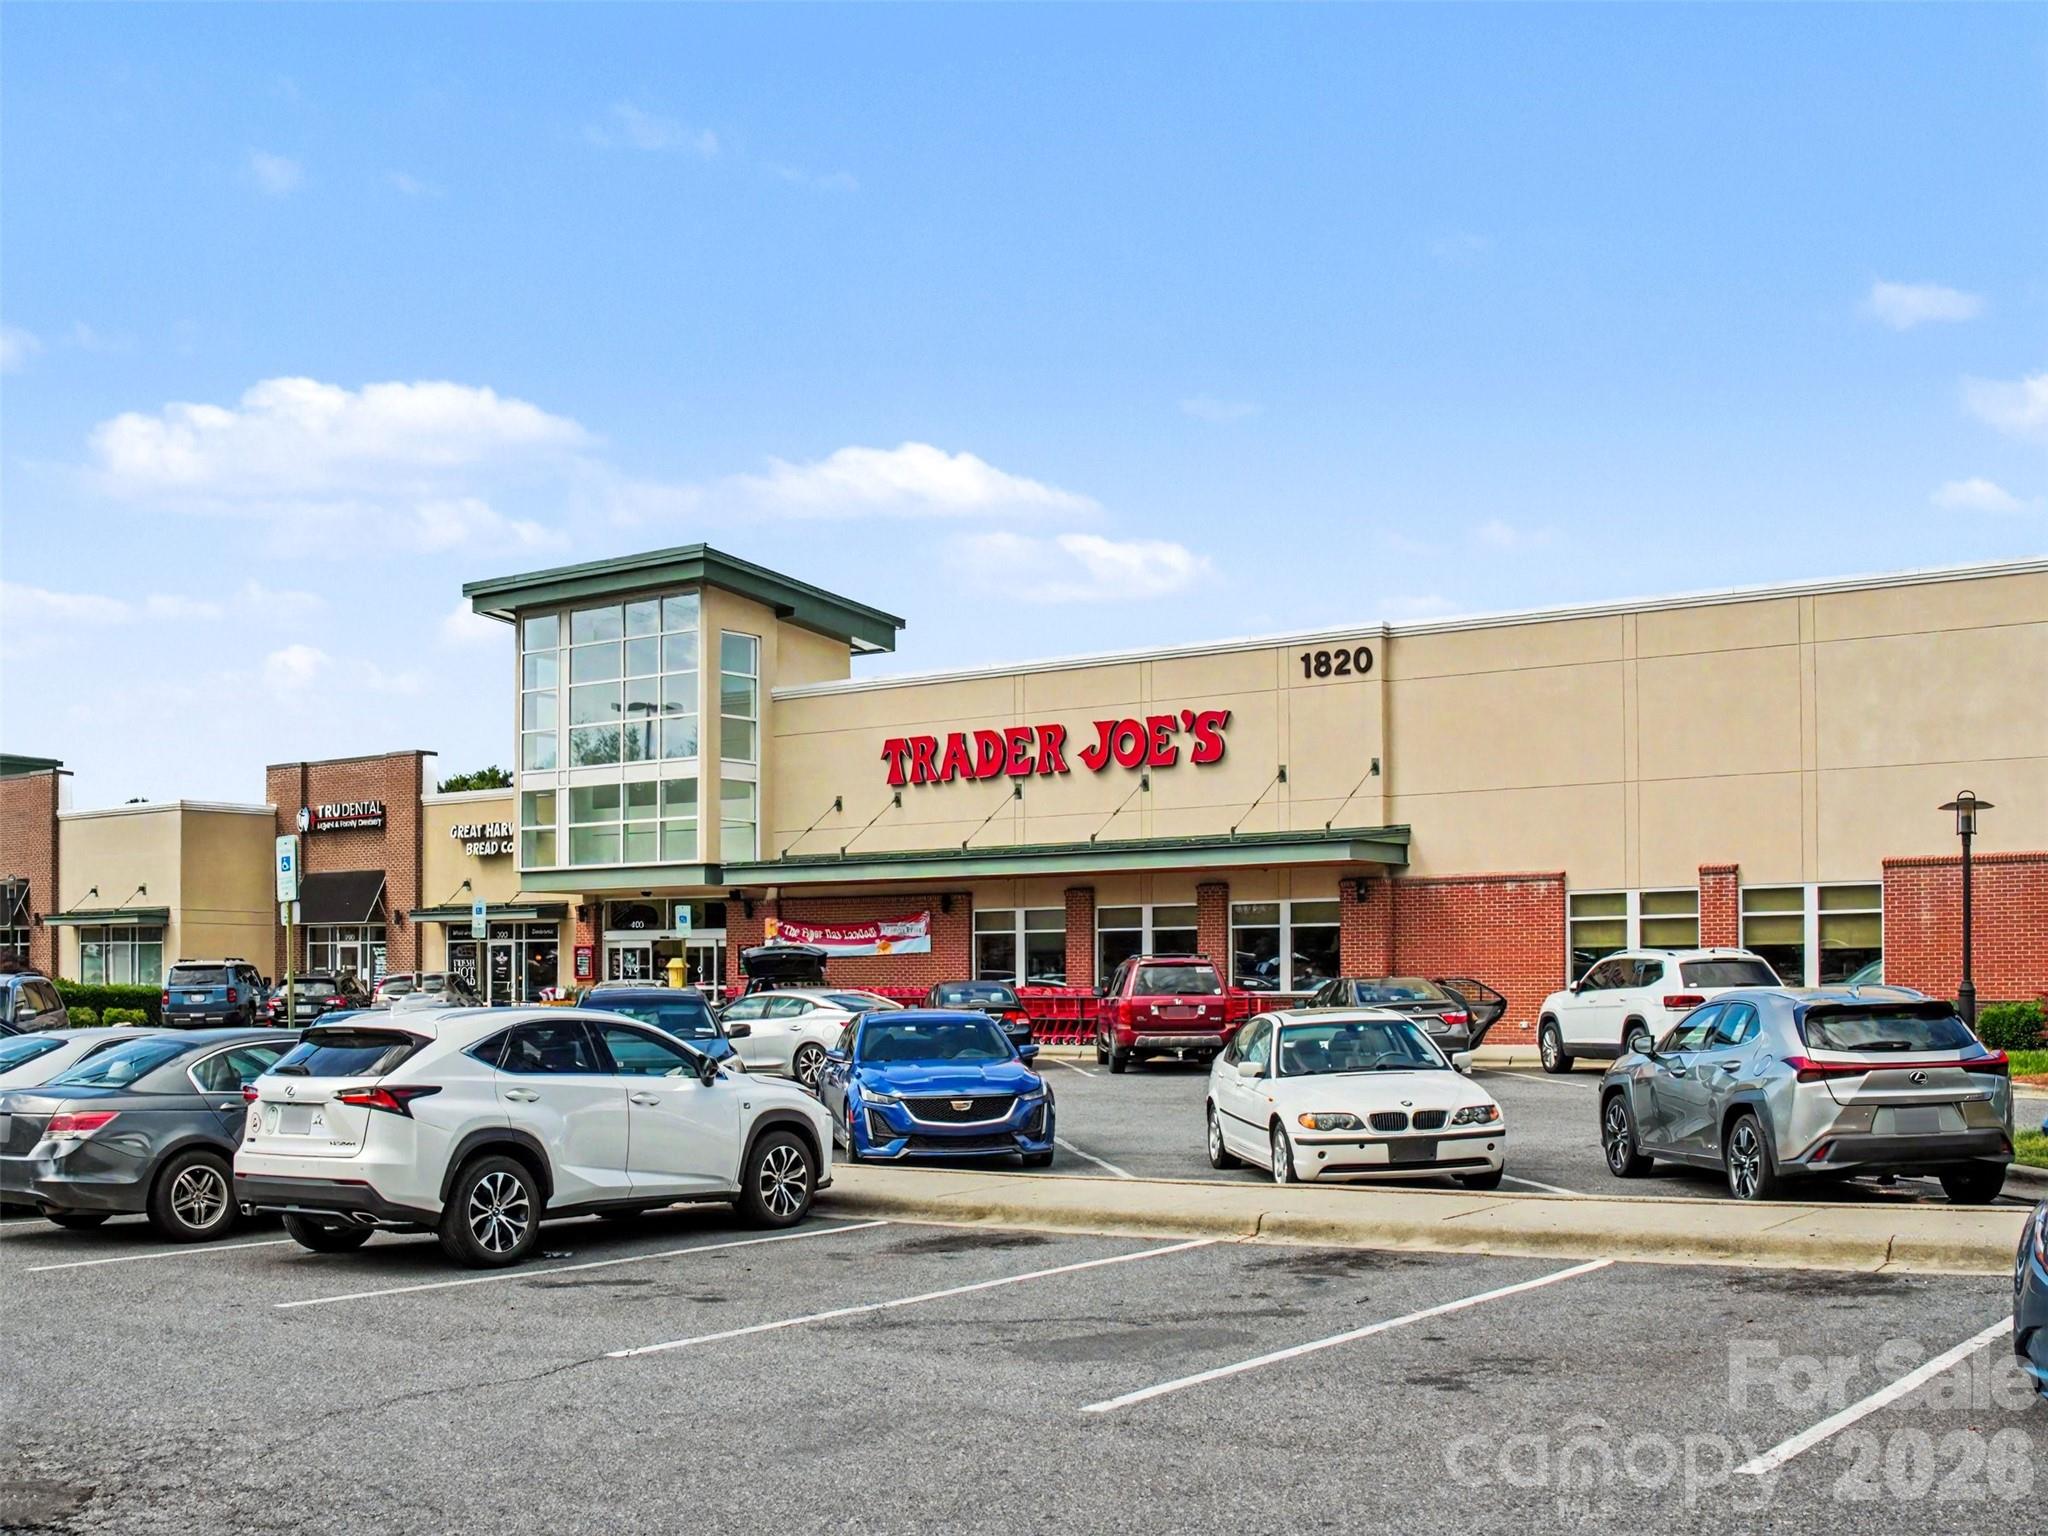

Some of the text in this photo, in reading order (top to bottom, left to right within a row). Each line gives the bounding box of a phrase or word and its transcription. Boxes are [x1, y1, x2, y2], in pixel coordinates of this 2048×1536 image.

[1300, 646, 1373, 679] 1820
[880, 709, 1231, 785] TRADER JOE'S
[450, 825, 482, 838] GREAT
[466, 841, 499, 856] BREAD
[784, 924, 800, 937] The
